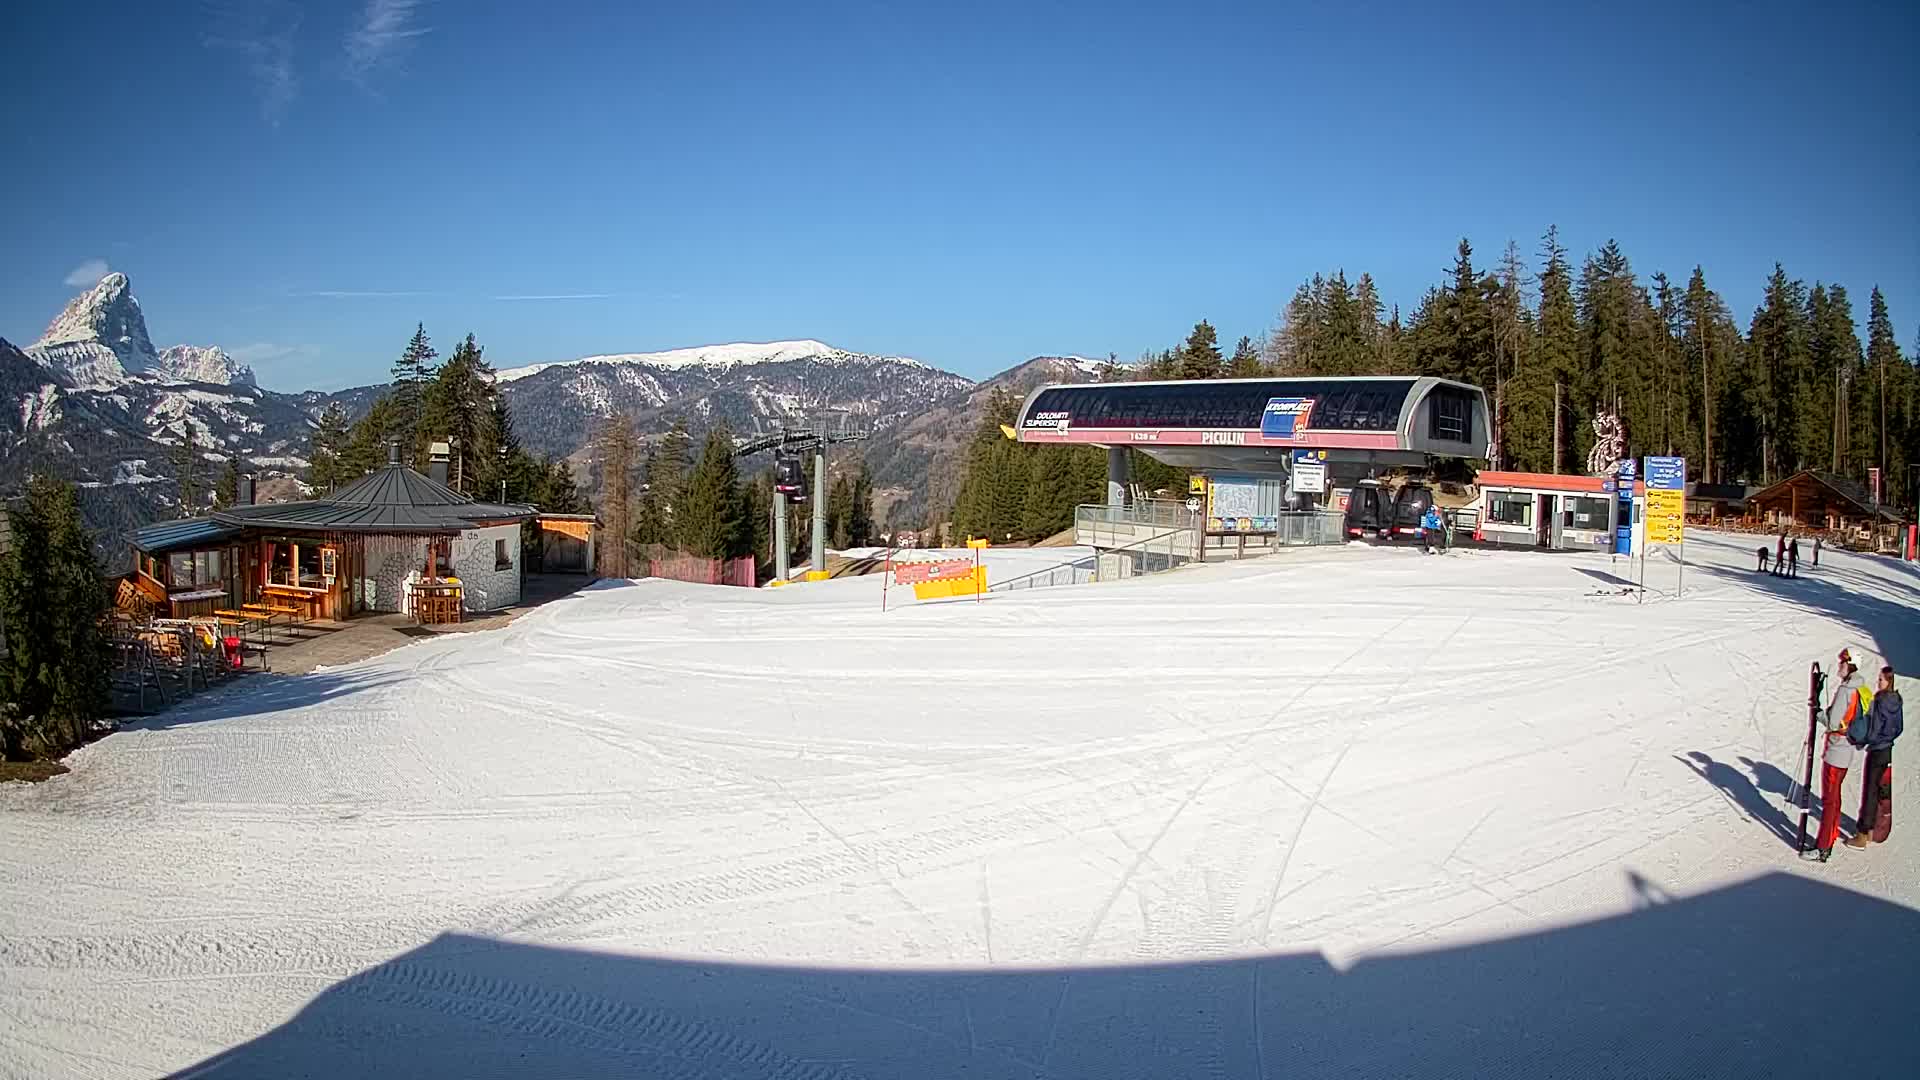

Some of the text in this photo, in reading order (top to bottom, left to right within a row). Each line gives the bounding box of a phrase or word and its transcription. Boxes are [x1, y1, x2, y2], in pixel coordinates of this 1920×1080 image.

[1036, 412, 1069, 420] DOLOMITI
[1025, 419, 1058, 427] SUPERSKI
[1201, 431, 1246, 445] PICULIN
